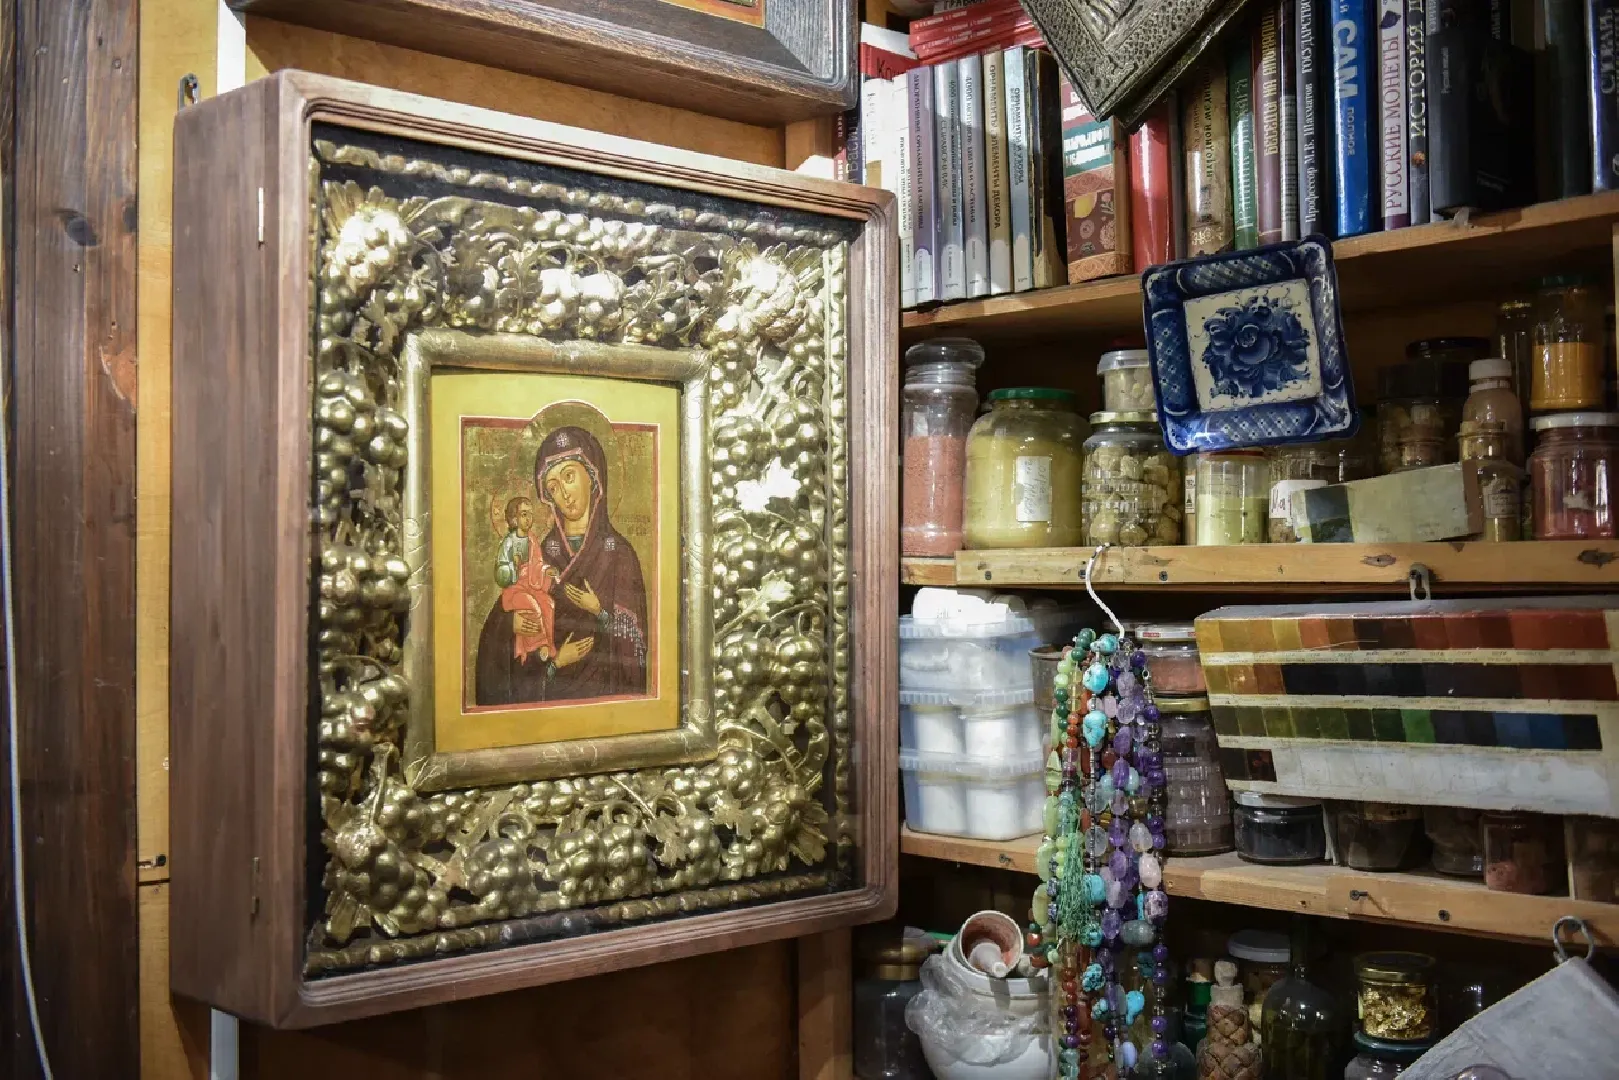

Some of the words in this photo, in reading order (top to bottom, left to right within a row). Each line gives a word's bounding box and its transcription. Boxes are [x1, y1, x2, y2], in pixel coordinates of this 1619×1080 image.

[1332, 20, 1358, 100] САМ
[1382, 35, 1401, 118] МОНЕТЫ
[1407, 20, 1426, 139] ИСТОРИЯ
[1263, 79, 1277, 98] НА
[1302, 83, 1315, 136] Шахматов
[1262, 101, 1279, 156] БЕСЕДЫ
[1383, 124, 1402, 209] РУССКИЕ
[993, 190, 1002, 229] ДЕКОРА
[1304, 167, 1320, 223] Профессор
